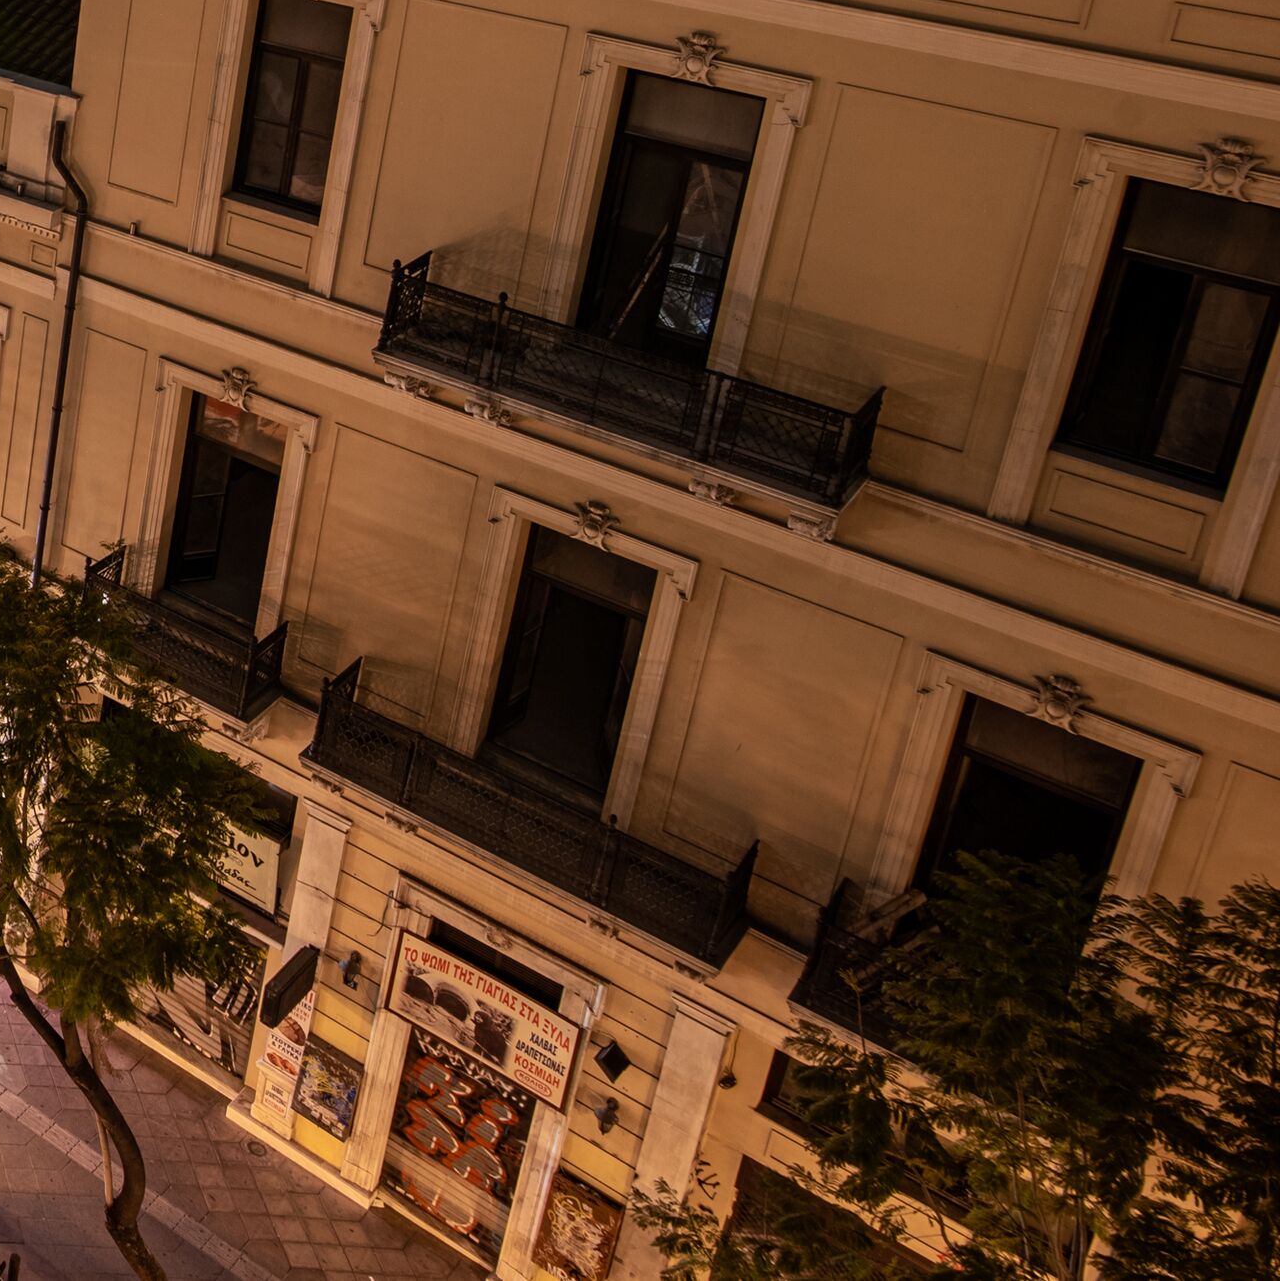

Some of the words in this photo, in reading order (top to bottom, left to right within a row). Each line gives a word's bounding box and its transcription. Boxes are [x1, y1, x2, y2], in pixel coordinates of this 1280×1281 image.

[404, 947, 418, 962] ΤΟ
[422, 952, 451, 975] ΨΩΜΙ
[454, 964, 475, 986] ΤΗΣ
[476, 976, 518, 1011] ΓΙΑΓΙΑΣ
[519, 1002, 540, 1028] ΣΤΑ
[542, 1019, 571, 1053] ΞΥΛΑ
[515, 1040, 566, 1077] ΔΡΑΠΕΤΣΩΝΑΣ
[530, 1032, 558, 1056] ΧΑΛΒΑΣ
[514, 1054, 561, 1089] ΚΟΣΜΙΔΗ
